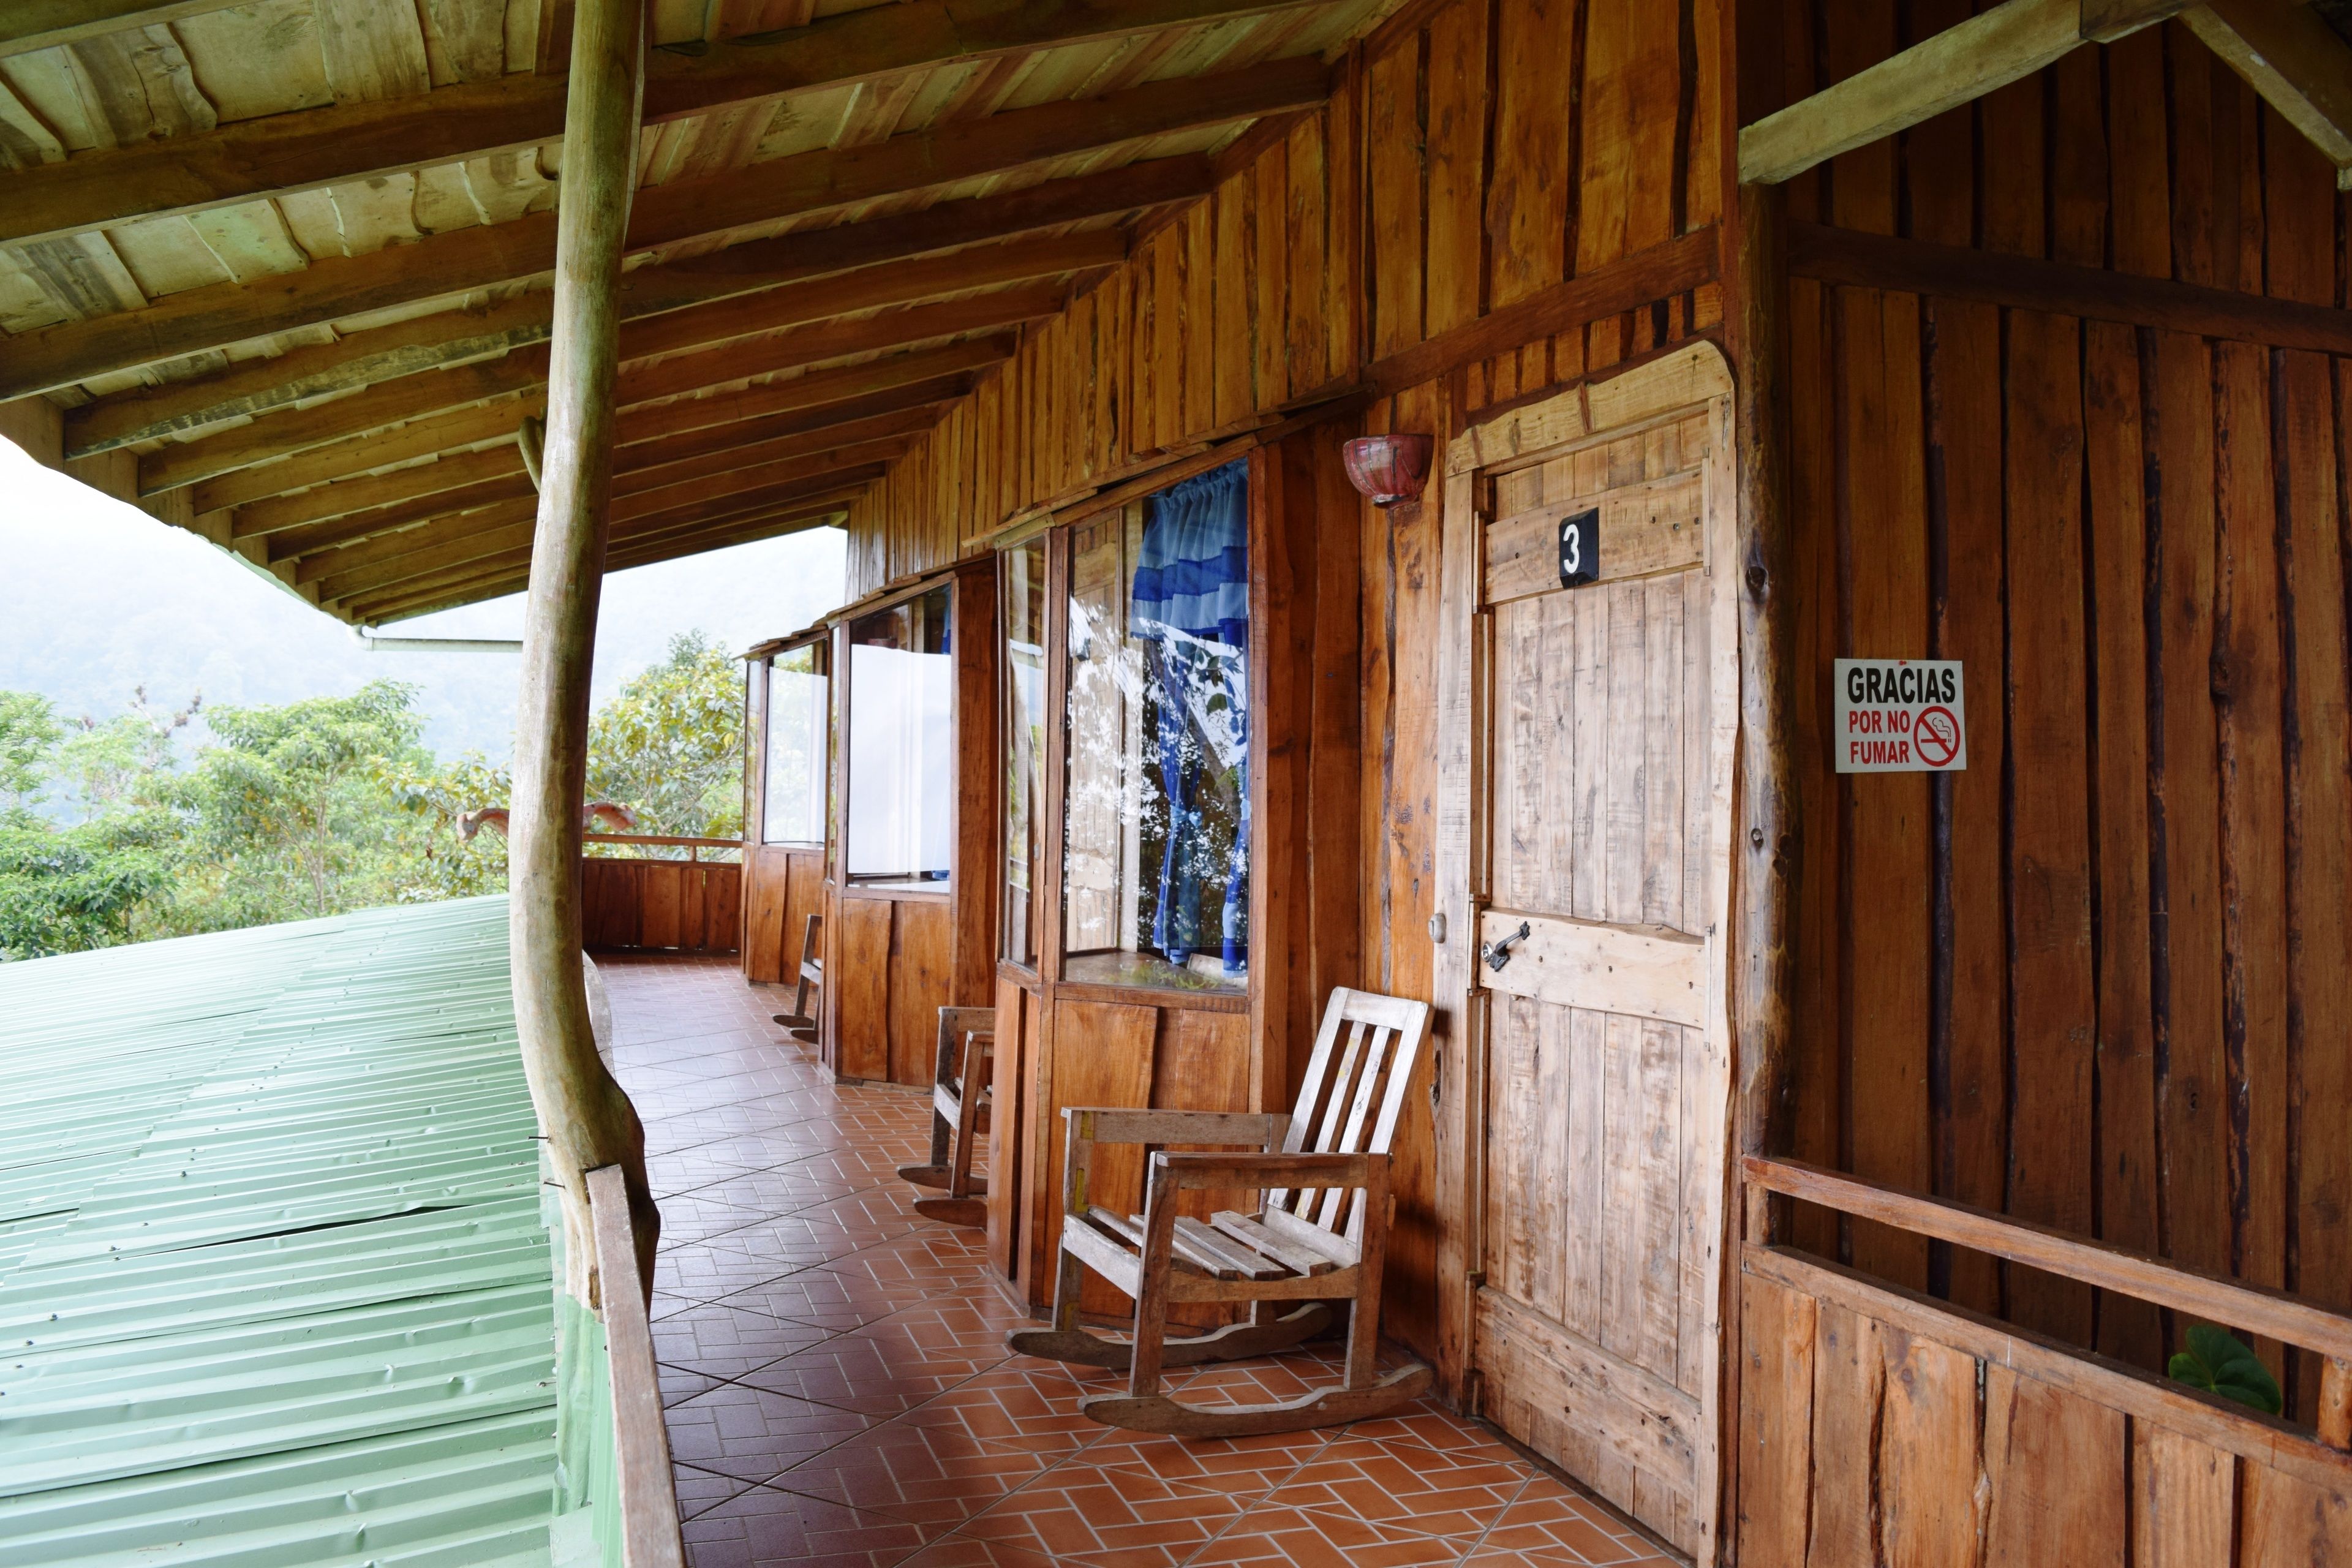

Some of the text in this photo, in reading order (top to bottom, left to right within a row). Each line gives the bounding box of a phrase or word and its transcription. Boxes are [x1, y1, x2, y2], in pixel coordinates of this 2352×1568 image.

[1563, 524, 1579, 573] 3
[1848, 667, 1955, 703] GRACIAS
[1849, 710, 1910, 733] POR NO
[1850, 741, 1910, 764] FUMAR
